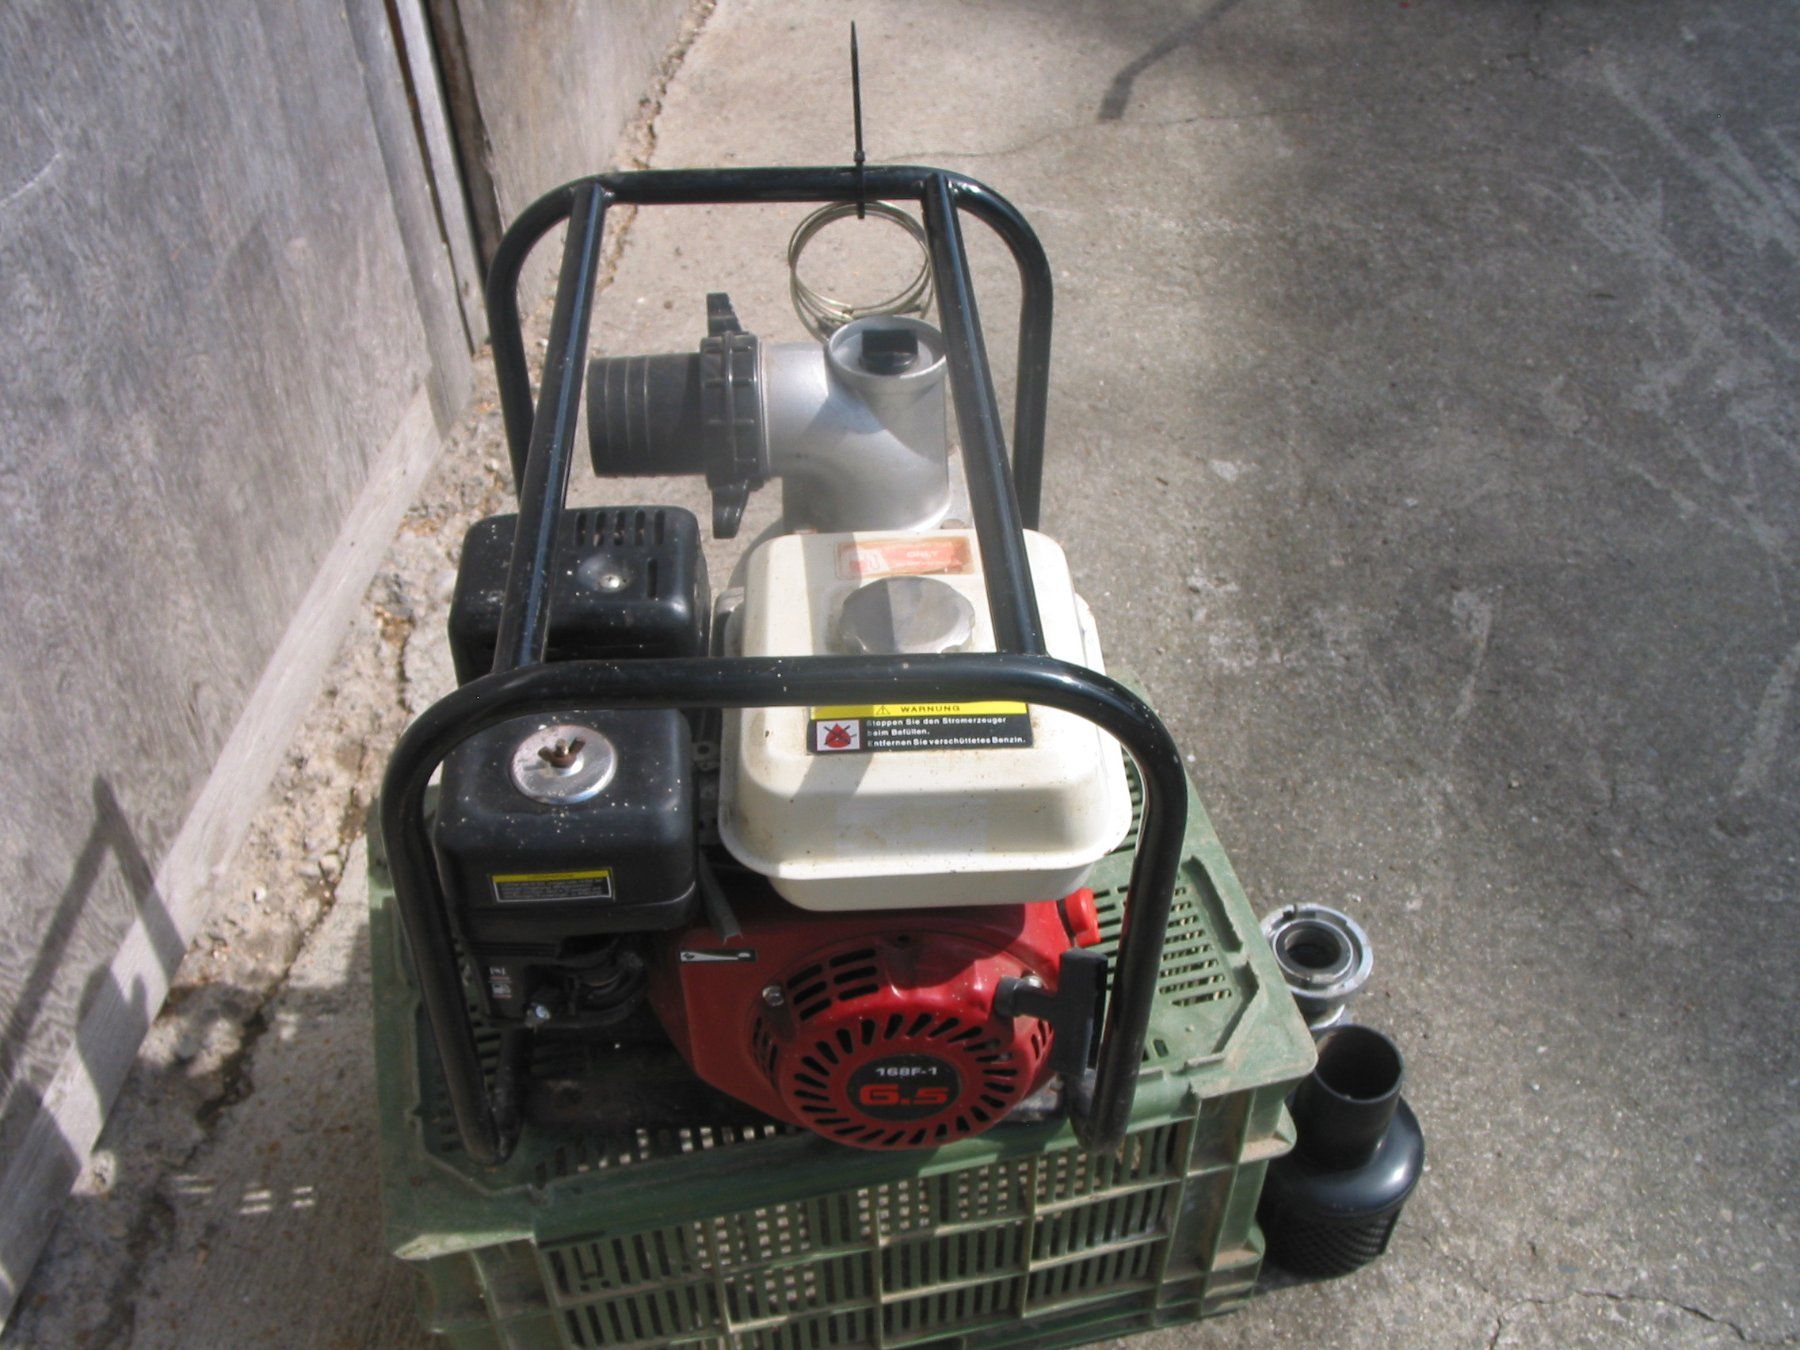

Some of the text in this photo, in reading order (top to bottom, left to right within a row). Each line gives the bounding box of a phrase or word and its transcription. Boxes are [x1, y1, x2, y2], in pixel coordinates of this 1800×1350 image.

[900, 705, 960, 713] WARNUNG
[942, 717, 1007, 725] Stromerzeuger
[913, 738, 928, 746] Sie
[992, 736, 1026, 744] Benzin.
[876, 1066, 937, 1077] 168F-1
